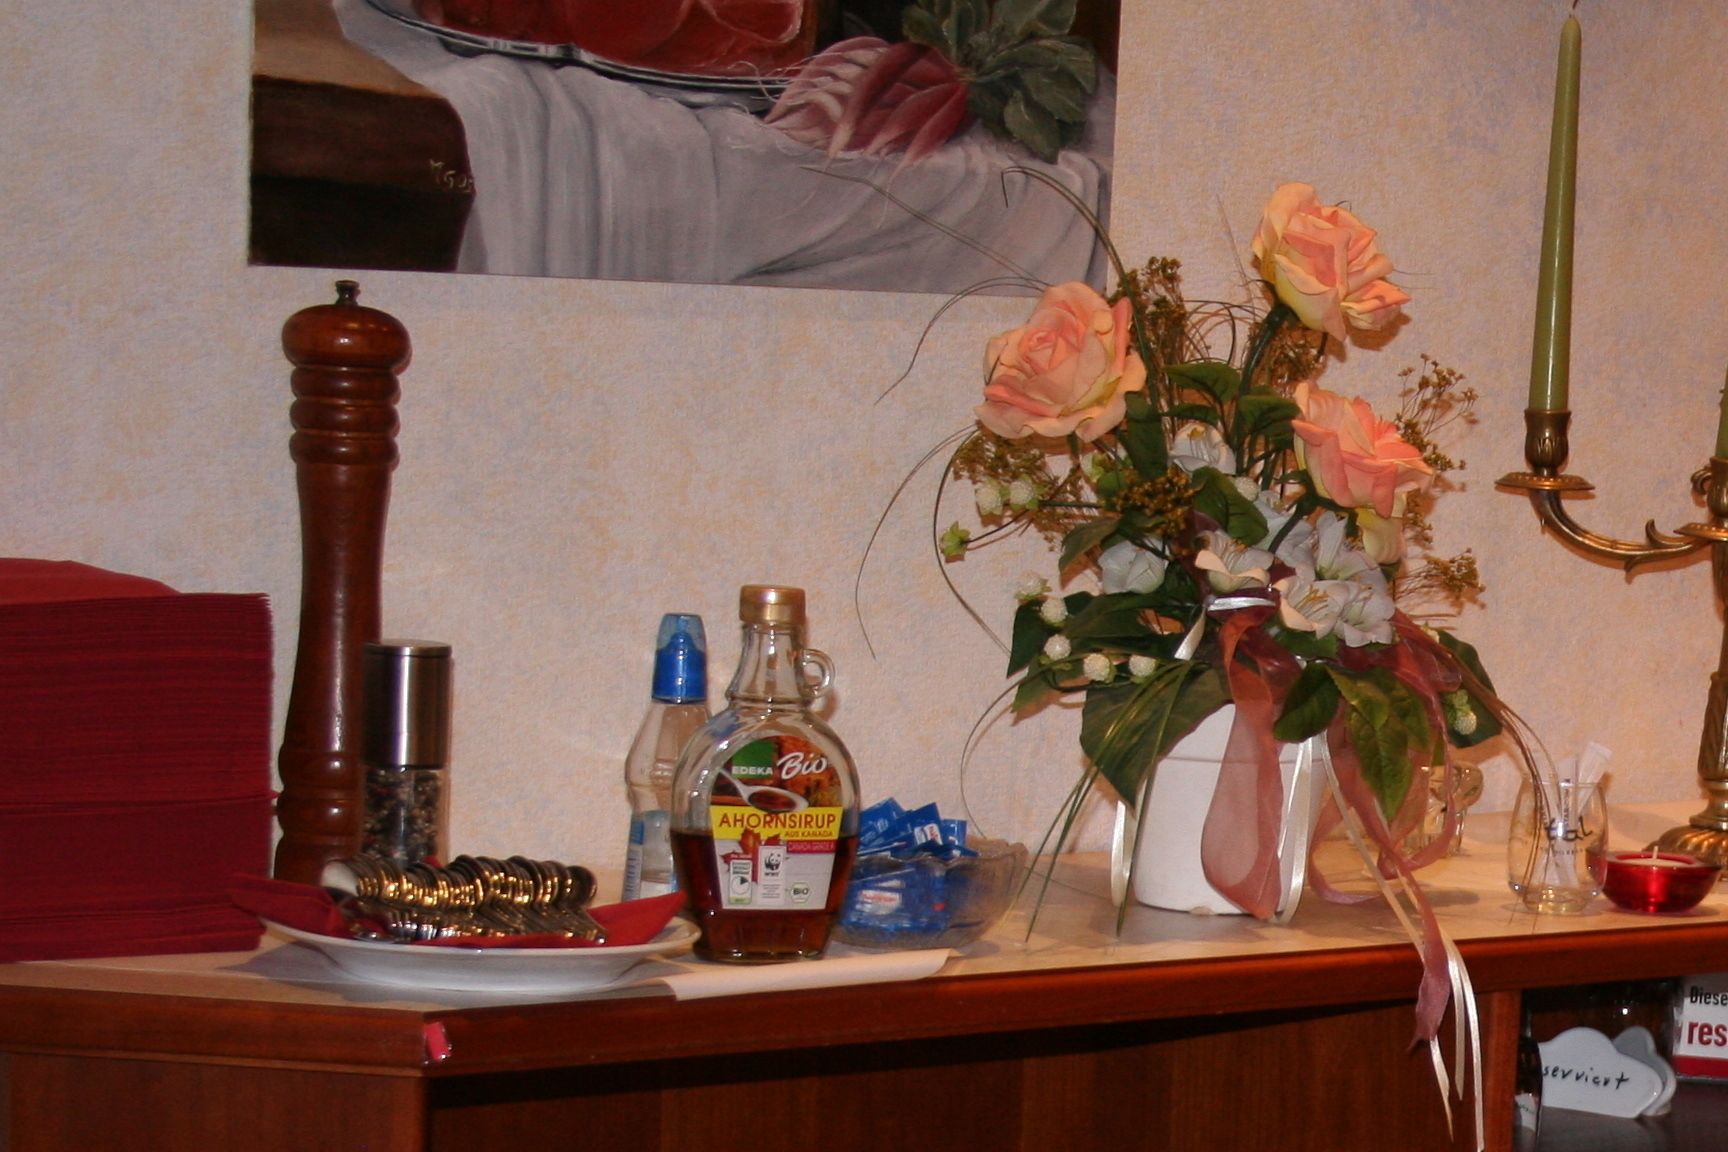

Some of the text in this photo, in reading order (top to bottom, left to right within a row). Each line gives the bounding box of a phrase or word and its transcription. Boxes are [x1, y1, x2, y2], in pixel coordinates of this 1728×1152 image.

[731, 751, 829, 780] EDEKA Bio
[719, 812, 837, 829] AHORNSIRUP
[1542, 1065, 1630, 1090] serviert
